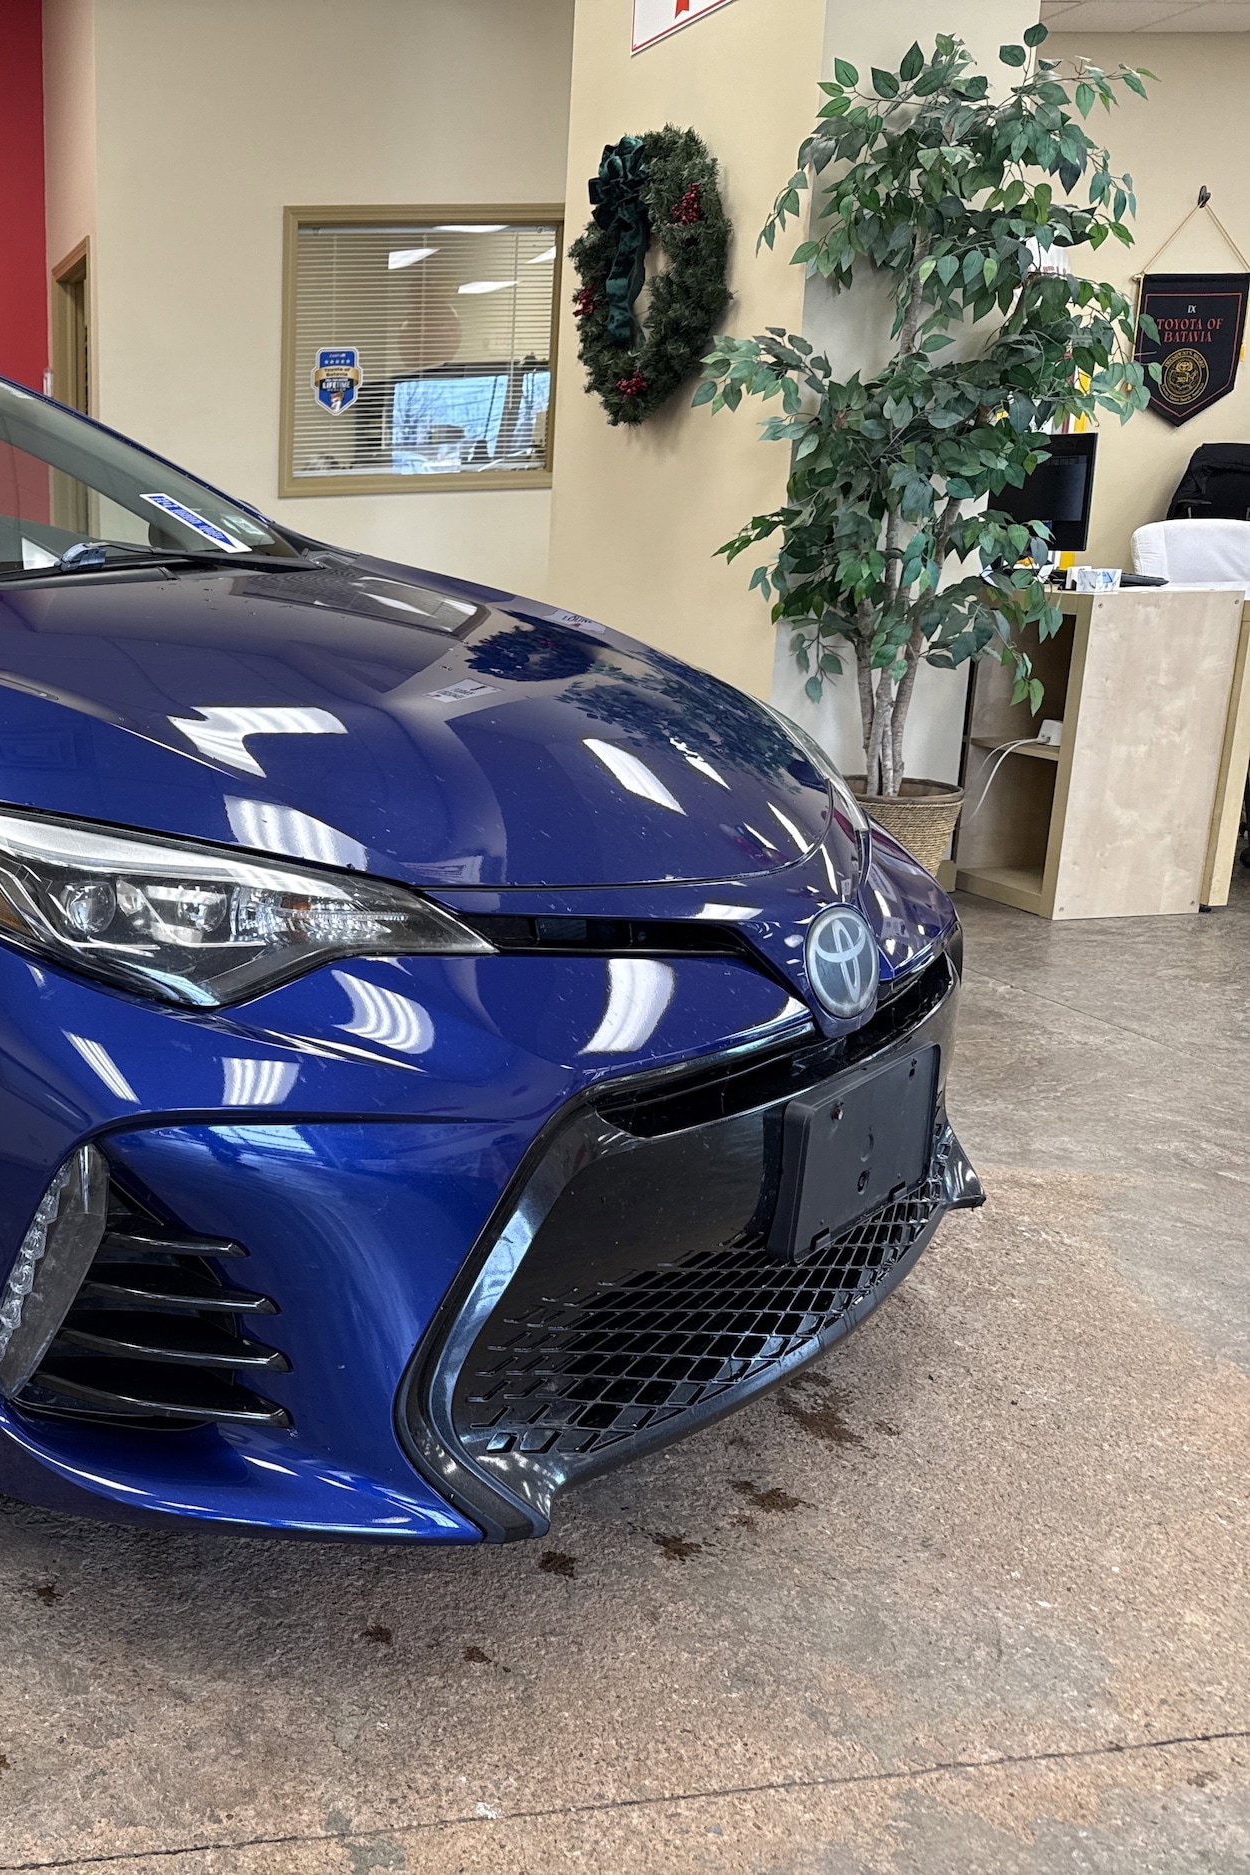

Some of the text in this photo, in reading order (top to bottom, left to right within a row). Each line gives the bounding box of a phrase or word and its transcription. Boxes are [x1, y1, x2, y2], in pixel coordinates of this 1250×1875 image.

[1187, 305, 1197, 313] IX
[1157, 318, 1223, 330] TOYOTA OF
[1163, 331, 1213, 343] BATAVIA
[322, 381, 351, 389] LIFETIME
